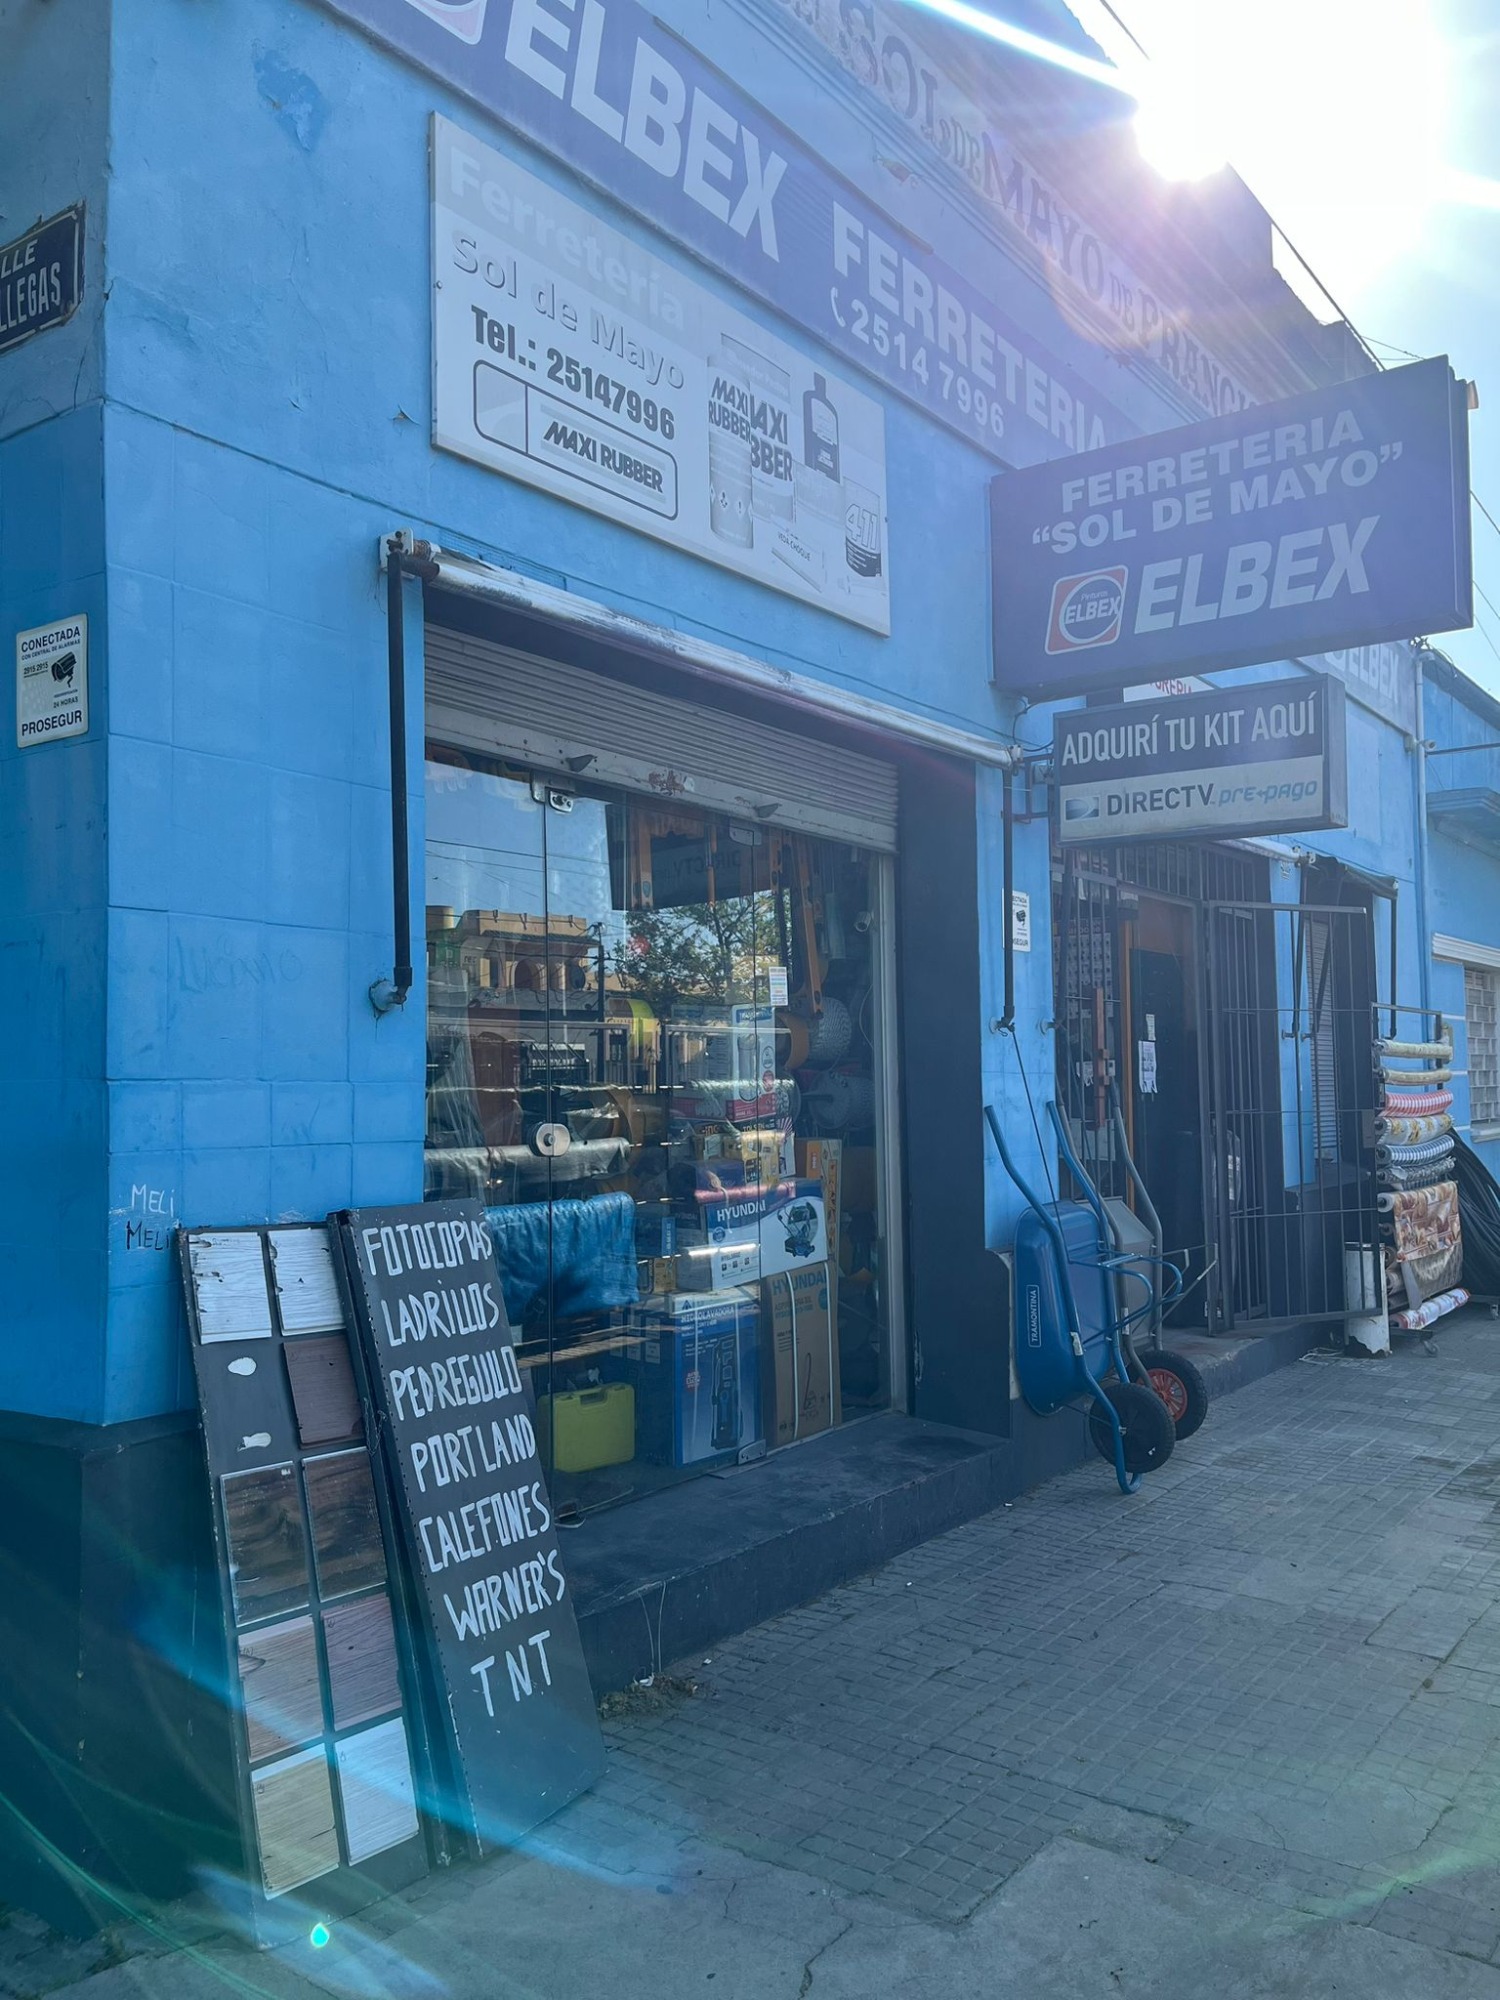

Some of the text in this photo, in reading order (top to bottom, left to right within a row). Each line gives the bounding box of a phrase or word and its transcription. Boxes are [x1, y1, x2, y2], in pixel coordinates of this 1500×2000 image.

[504, 0, 788, 263] ELBEX
[452, 228, 518, 299] Sol
[531, 279, 579, 333] de
[590, 305, 685, 391] Mayo
[833, 200, 1107, 454] FERRETERIA
[546, 347, 675, 441] 25147996
[711, 376, 750, 419] MAXI
[850, 299, 930, 386] 2514
[938, 360, 1005, 438] 7996
[708, 399, 752, 446] RUBBER
[543, 420, 598, 464] MAXI
[600, 442, 664, 494] RUBBER
[1062, 409, 1364, 514] FERRETERIA
[1151, 487, 1214, 533] DE
[1134, 514, 1381, 636] ELBEX
[21, 626, 81, 653] CONECTADA
[1065, 595, 1121, 625] ELBEX
[31, 647, 52, 659] CENTRAL
[57, 638, 81, 650] ALARMAS
[1348, 643, 1399, 705] ELBEX
[21, 709, 82, 737] PROSEGUR
[59, 696, 79, 706] HORAS
[1062, 691, 1318, 768] ADQUIRÍ TU KIT AQUÍ
[1107, 782, 1214, 817] DIRECTV
[361, 1212, 493, 1277] FOTOCOPIAS
[717, 1199, 767, 1222] HYUNDAI
[380, 1279, 500, 1347] LADRILLOS
[1029, 1289, 1039, 1344] TRAMONTINA
[388, 1345, 523, 1422] PEDREGULLO
[410, 1413, 537, 1494] PORTLAND
[418, 1480, 551, 1574] CALEFONES
[442, 1548, 566, 1642] WARNER'S
